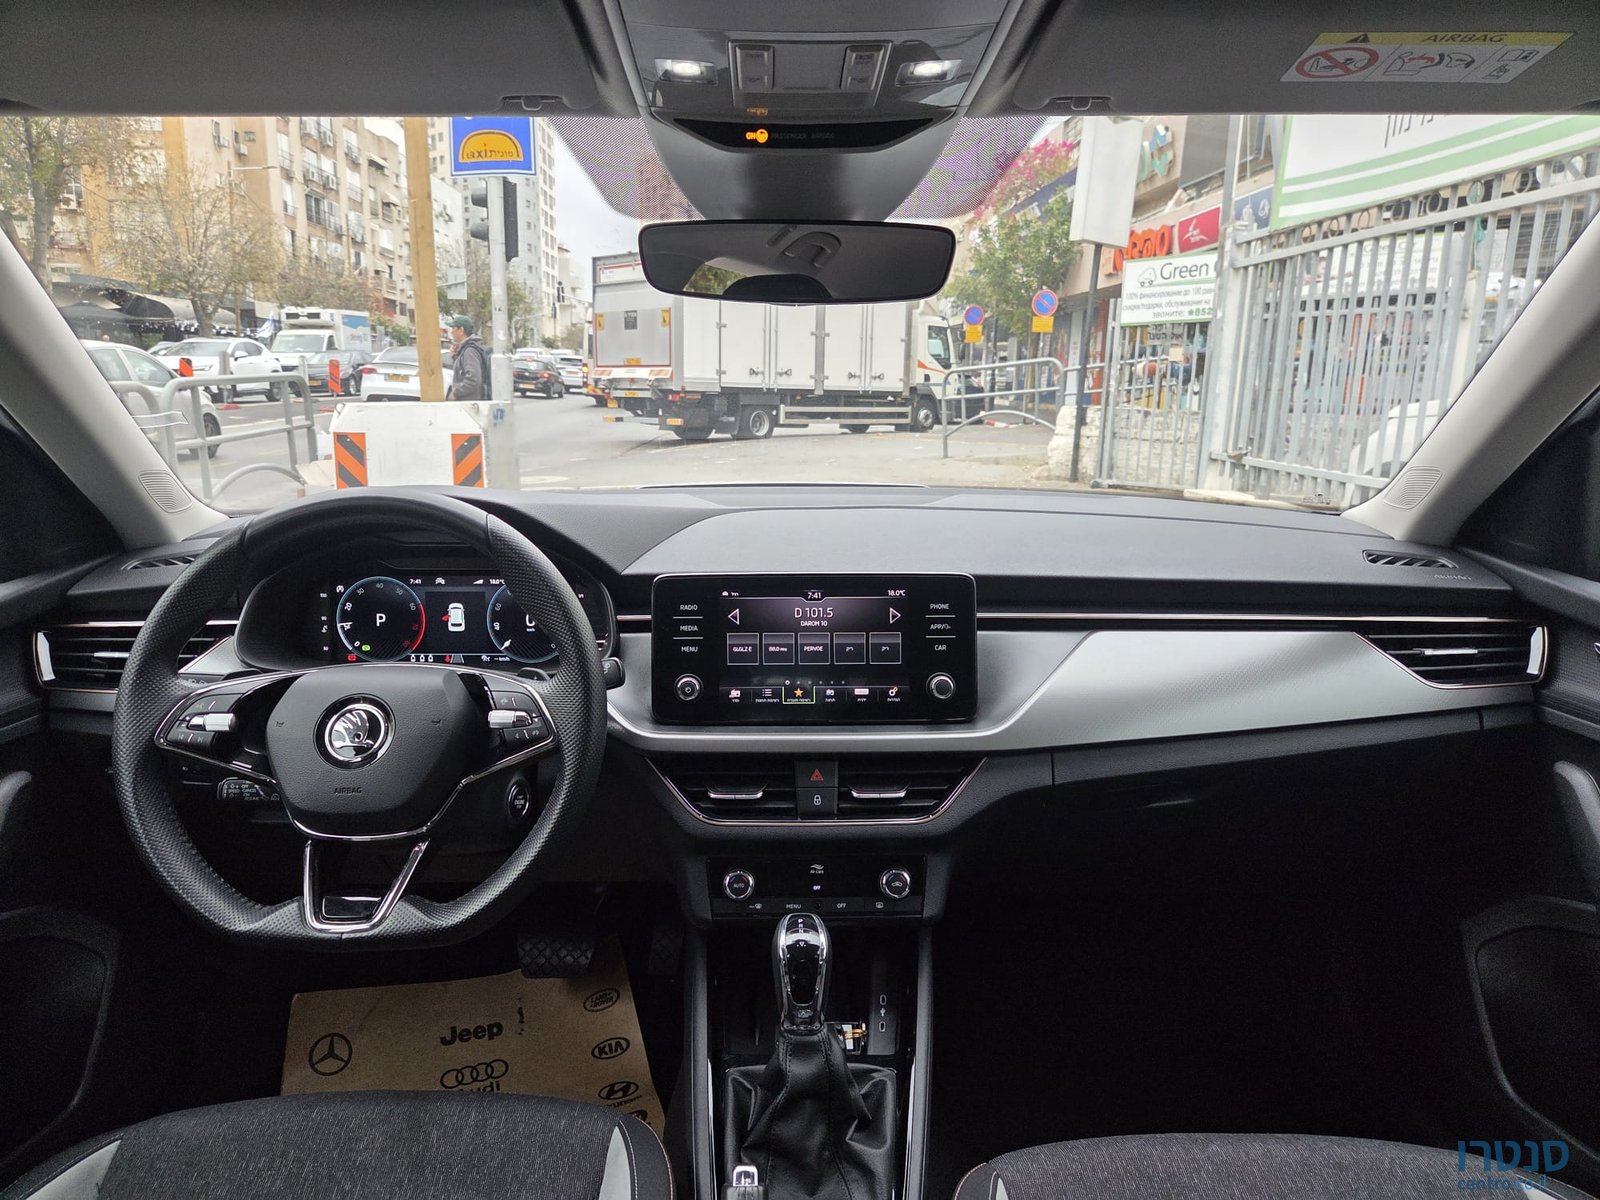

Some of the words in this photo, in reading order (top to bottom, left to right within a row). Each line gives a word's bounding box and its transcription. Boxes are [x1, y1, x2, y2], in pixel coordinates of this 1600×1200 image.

[1421, 33, 1507, 43] AIRBAG
[1160, 262, 1209, 280] Green
[344, 602, 353, 611] 20
[794, 608, 802, 618] D
[805, 608, 833, 618] 101.5
[376, 613, 386, 627] P
[493, 622, 500, 631] 40
[439, 1021, 504, 1046] Jeep
[597, 1040, 625, 1057] KIA
